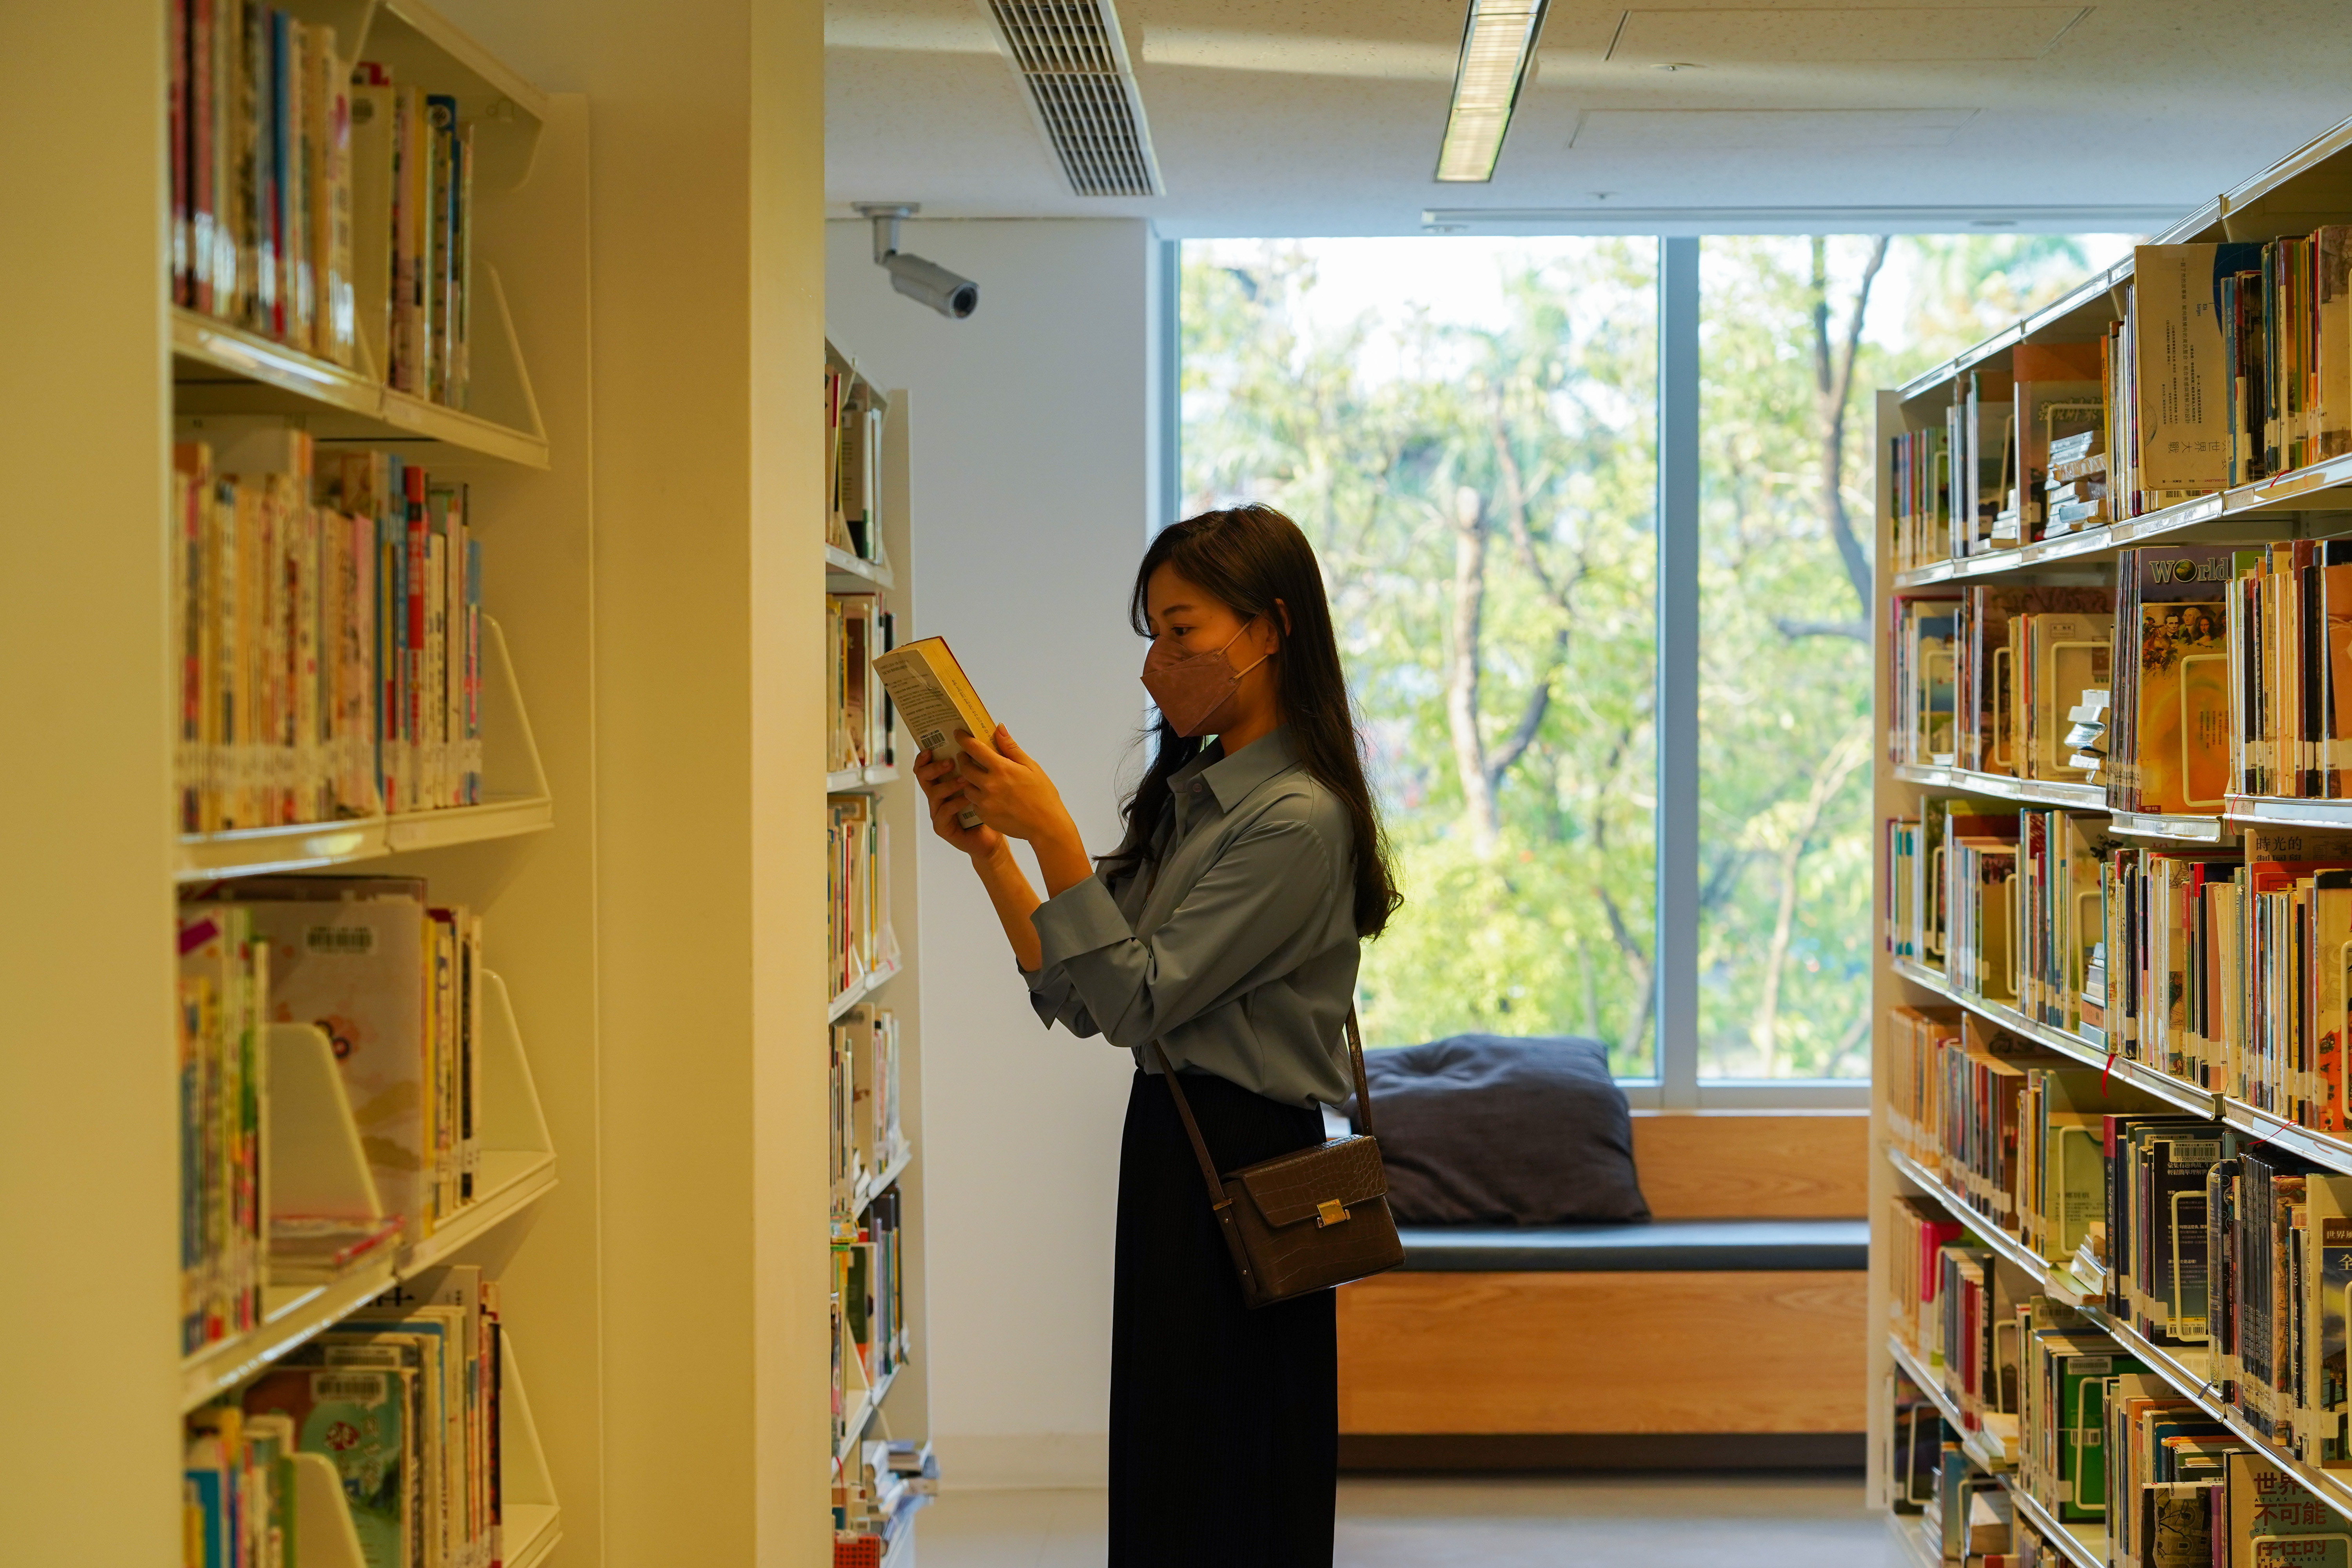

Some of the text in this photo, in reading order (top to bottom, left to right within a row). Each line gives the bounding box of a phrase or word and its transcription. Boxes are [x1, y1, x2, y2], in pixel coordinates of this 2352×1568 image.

[2149, 557, 2230, 584] World
[2256, 836, 2302, 851] 時光的
[2254, 1472, 2314, 1495] 世界
[2254, 1501, 2327, 1526] 不可能
